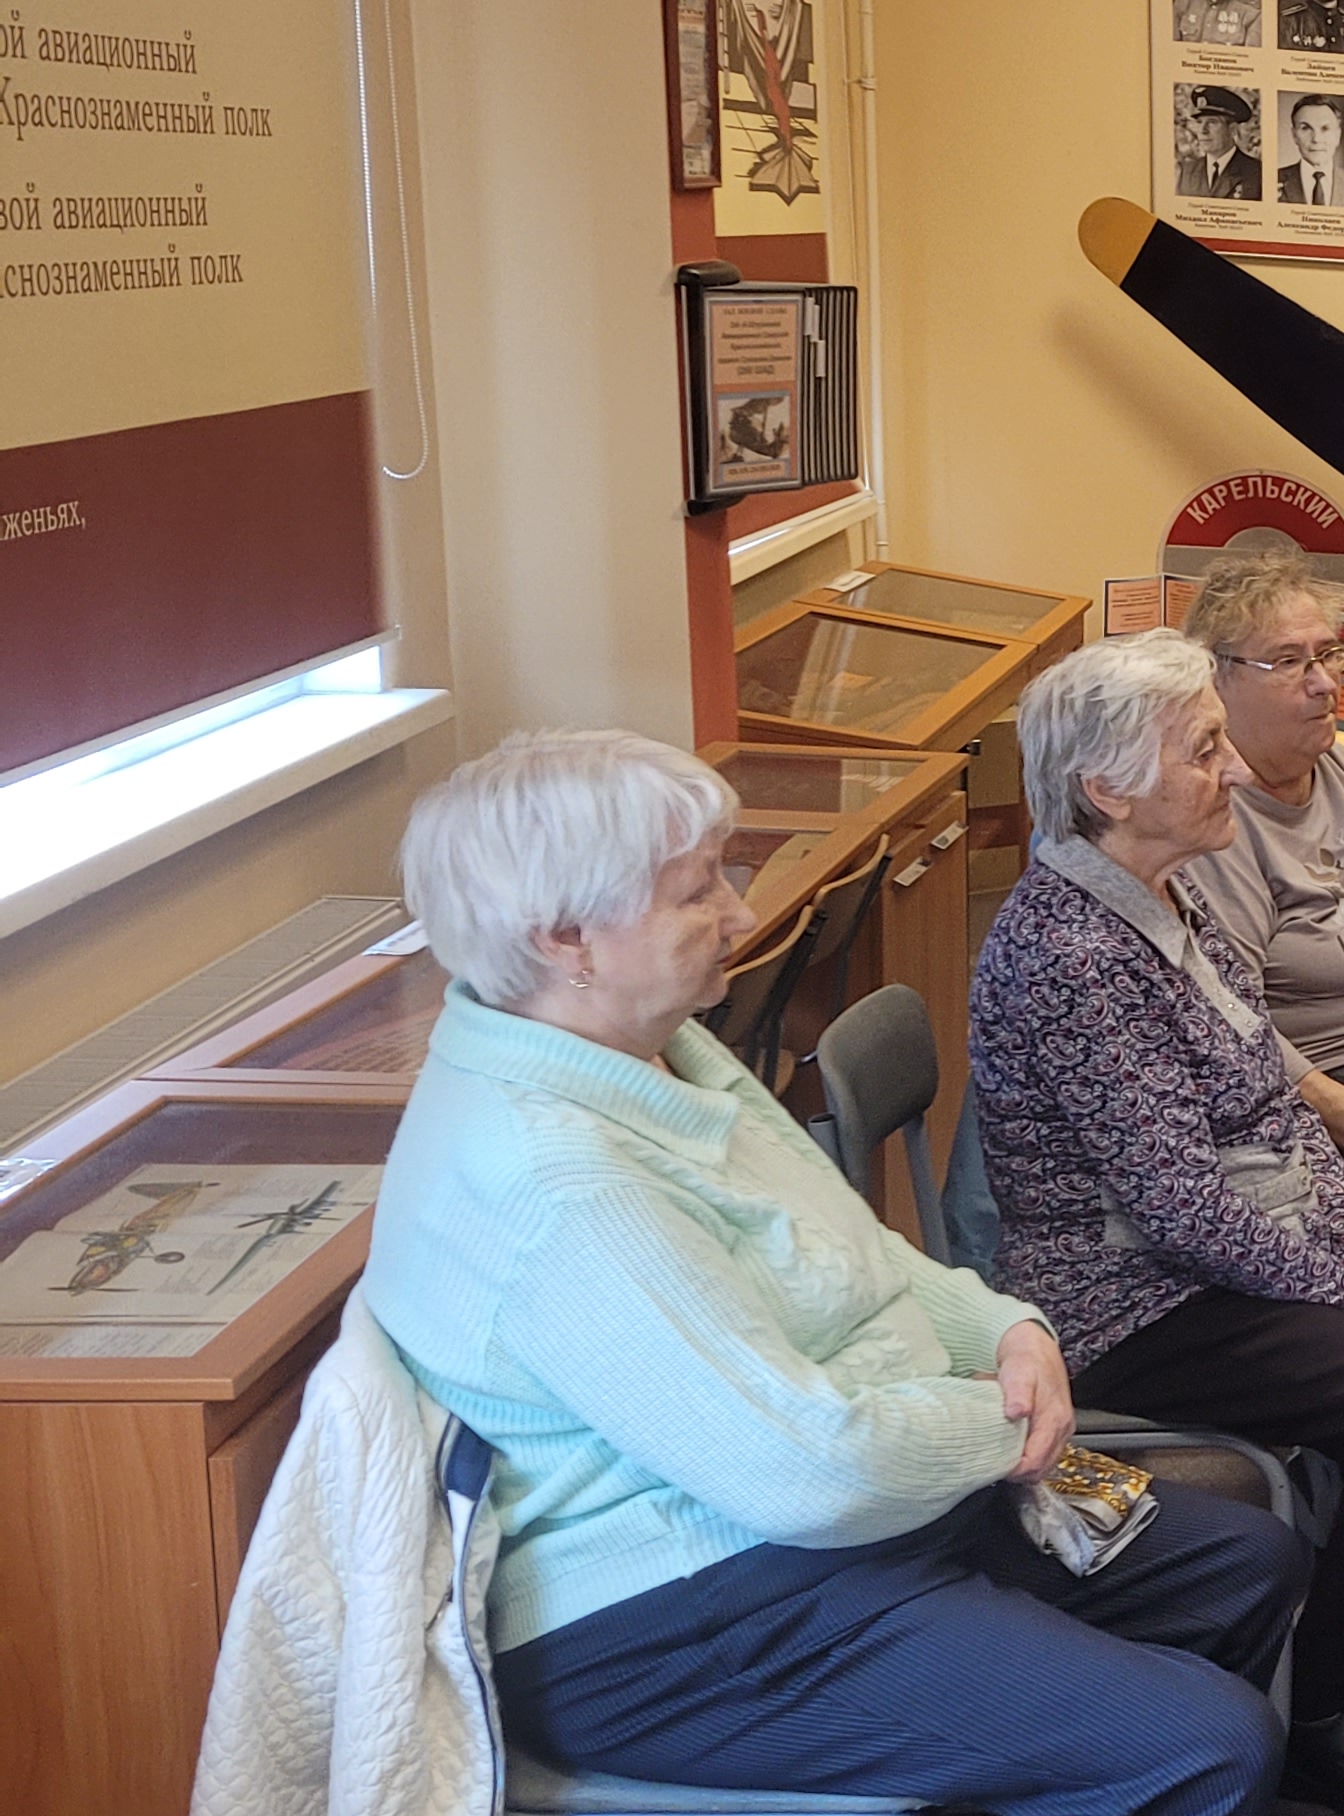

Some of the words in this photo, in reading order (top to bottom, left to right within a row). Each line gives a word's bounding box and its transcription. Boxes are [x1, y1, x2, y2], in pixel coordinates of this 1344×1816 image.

[38, 28, 198, 75] авиационный
[223, 106, 273, 137] полк
[53, 183, 208, 235] авиационный
[189, 254, 244, 286] полк
[0, 500, 87, 541] женьях,
